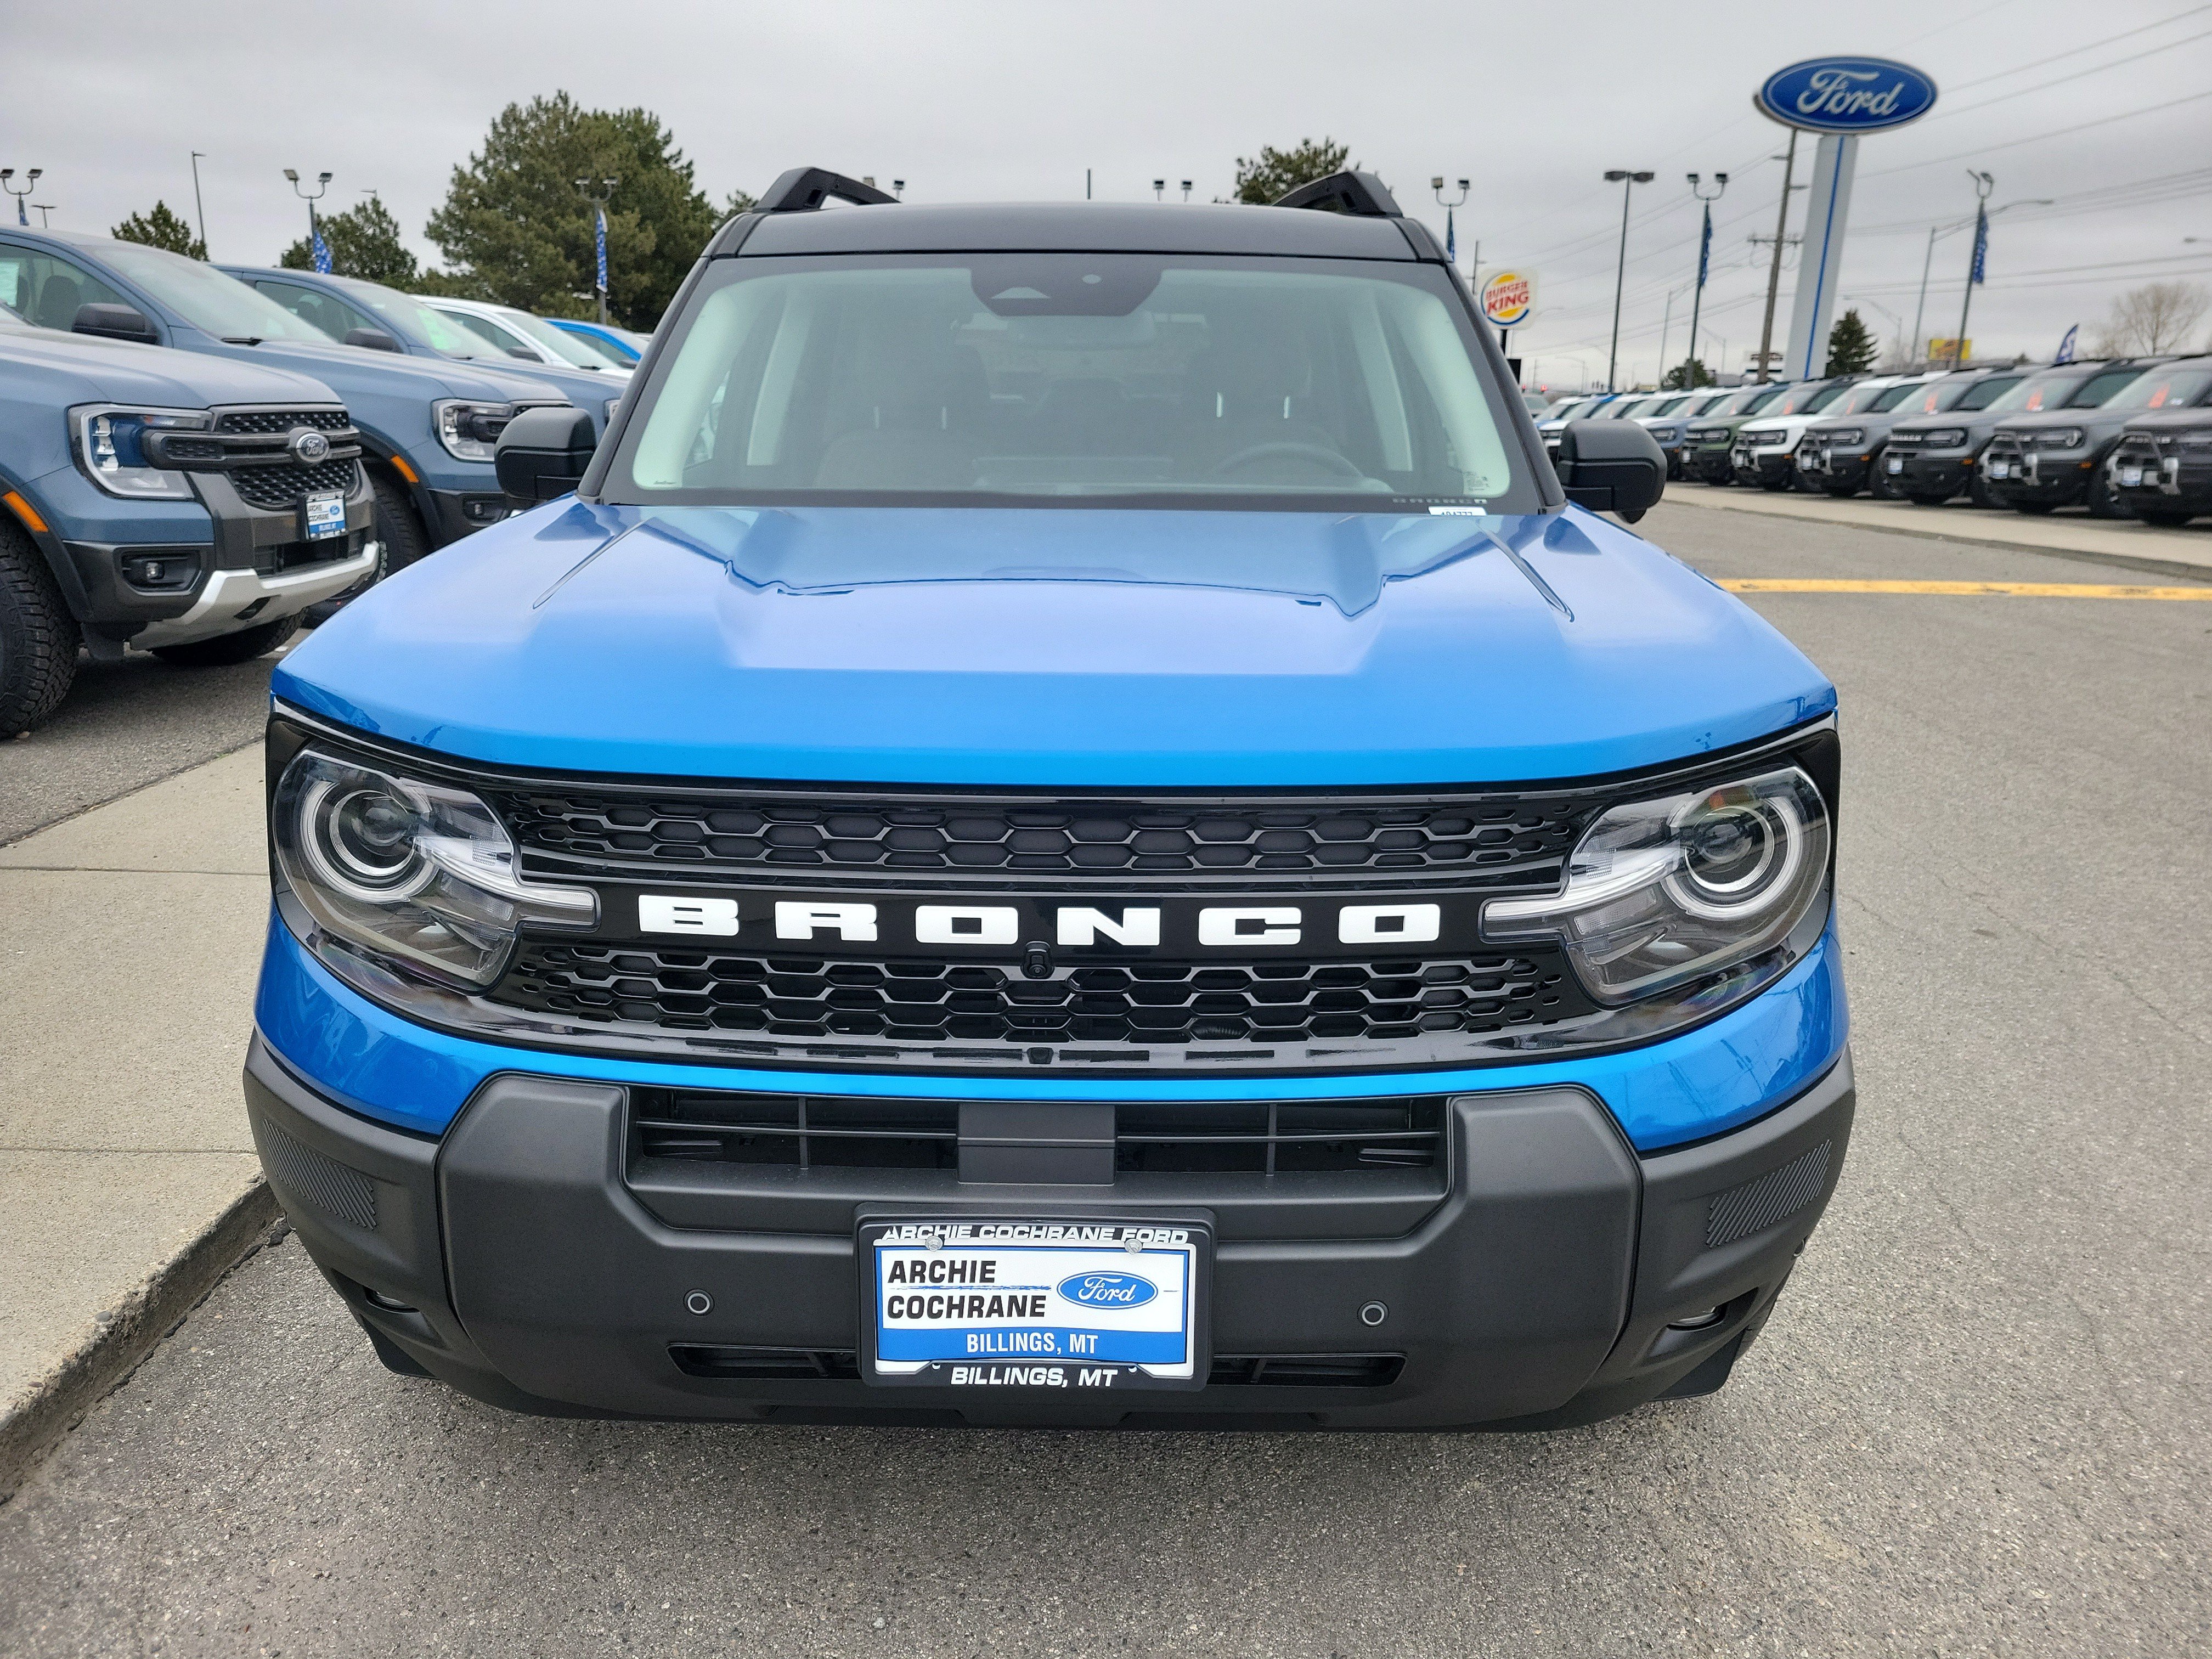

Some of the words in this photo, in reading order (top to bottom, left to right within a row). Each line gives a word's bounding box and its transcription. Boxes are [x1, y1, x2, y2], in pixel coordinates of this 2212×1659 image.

[1797, 68, 1904, 115] Ford
[1486, 281, 1527, 301] BURGER
[1487, 291, 1529, 315] KING
[639, 895, 1441, 946] BRONCO
[882, 1225, 973, 1240] ARCHIE
[979, 1225, 1115, 1242] COCHRANE
[1121, 1227, 1189, 1244] FORD
[887, 1260, 996, 1283] ARCHIE
[1077, 1276, 1137, 1301] Ford
[887, 1295, 1046, 1319] COCHRANE
[967, 1332, 1062, 1355] BILLINGS,
[1069, 1334, 1098, 1354] MT
[951, 1367, 1068, 1387] BILLINGS,
[1078, 1368, 1118, 1386] MT
